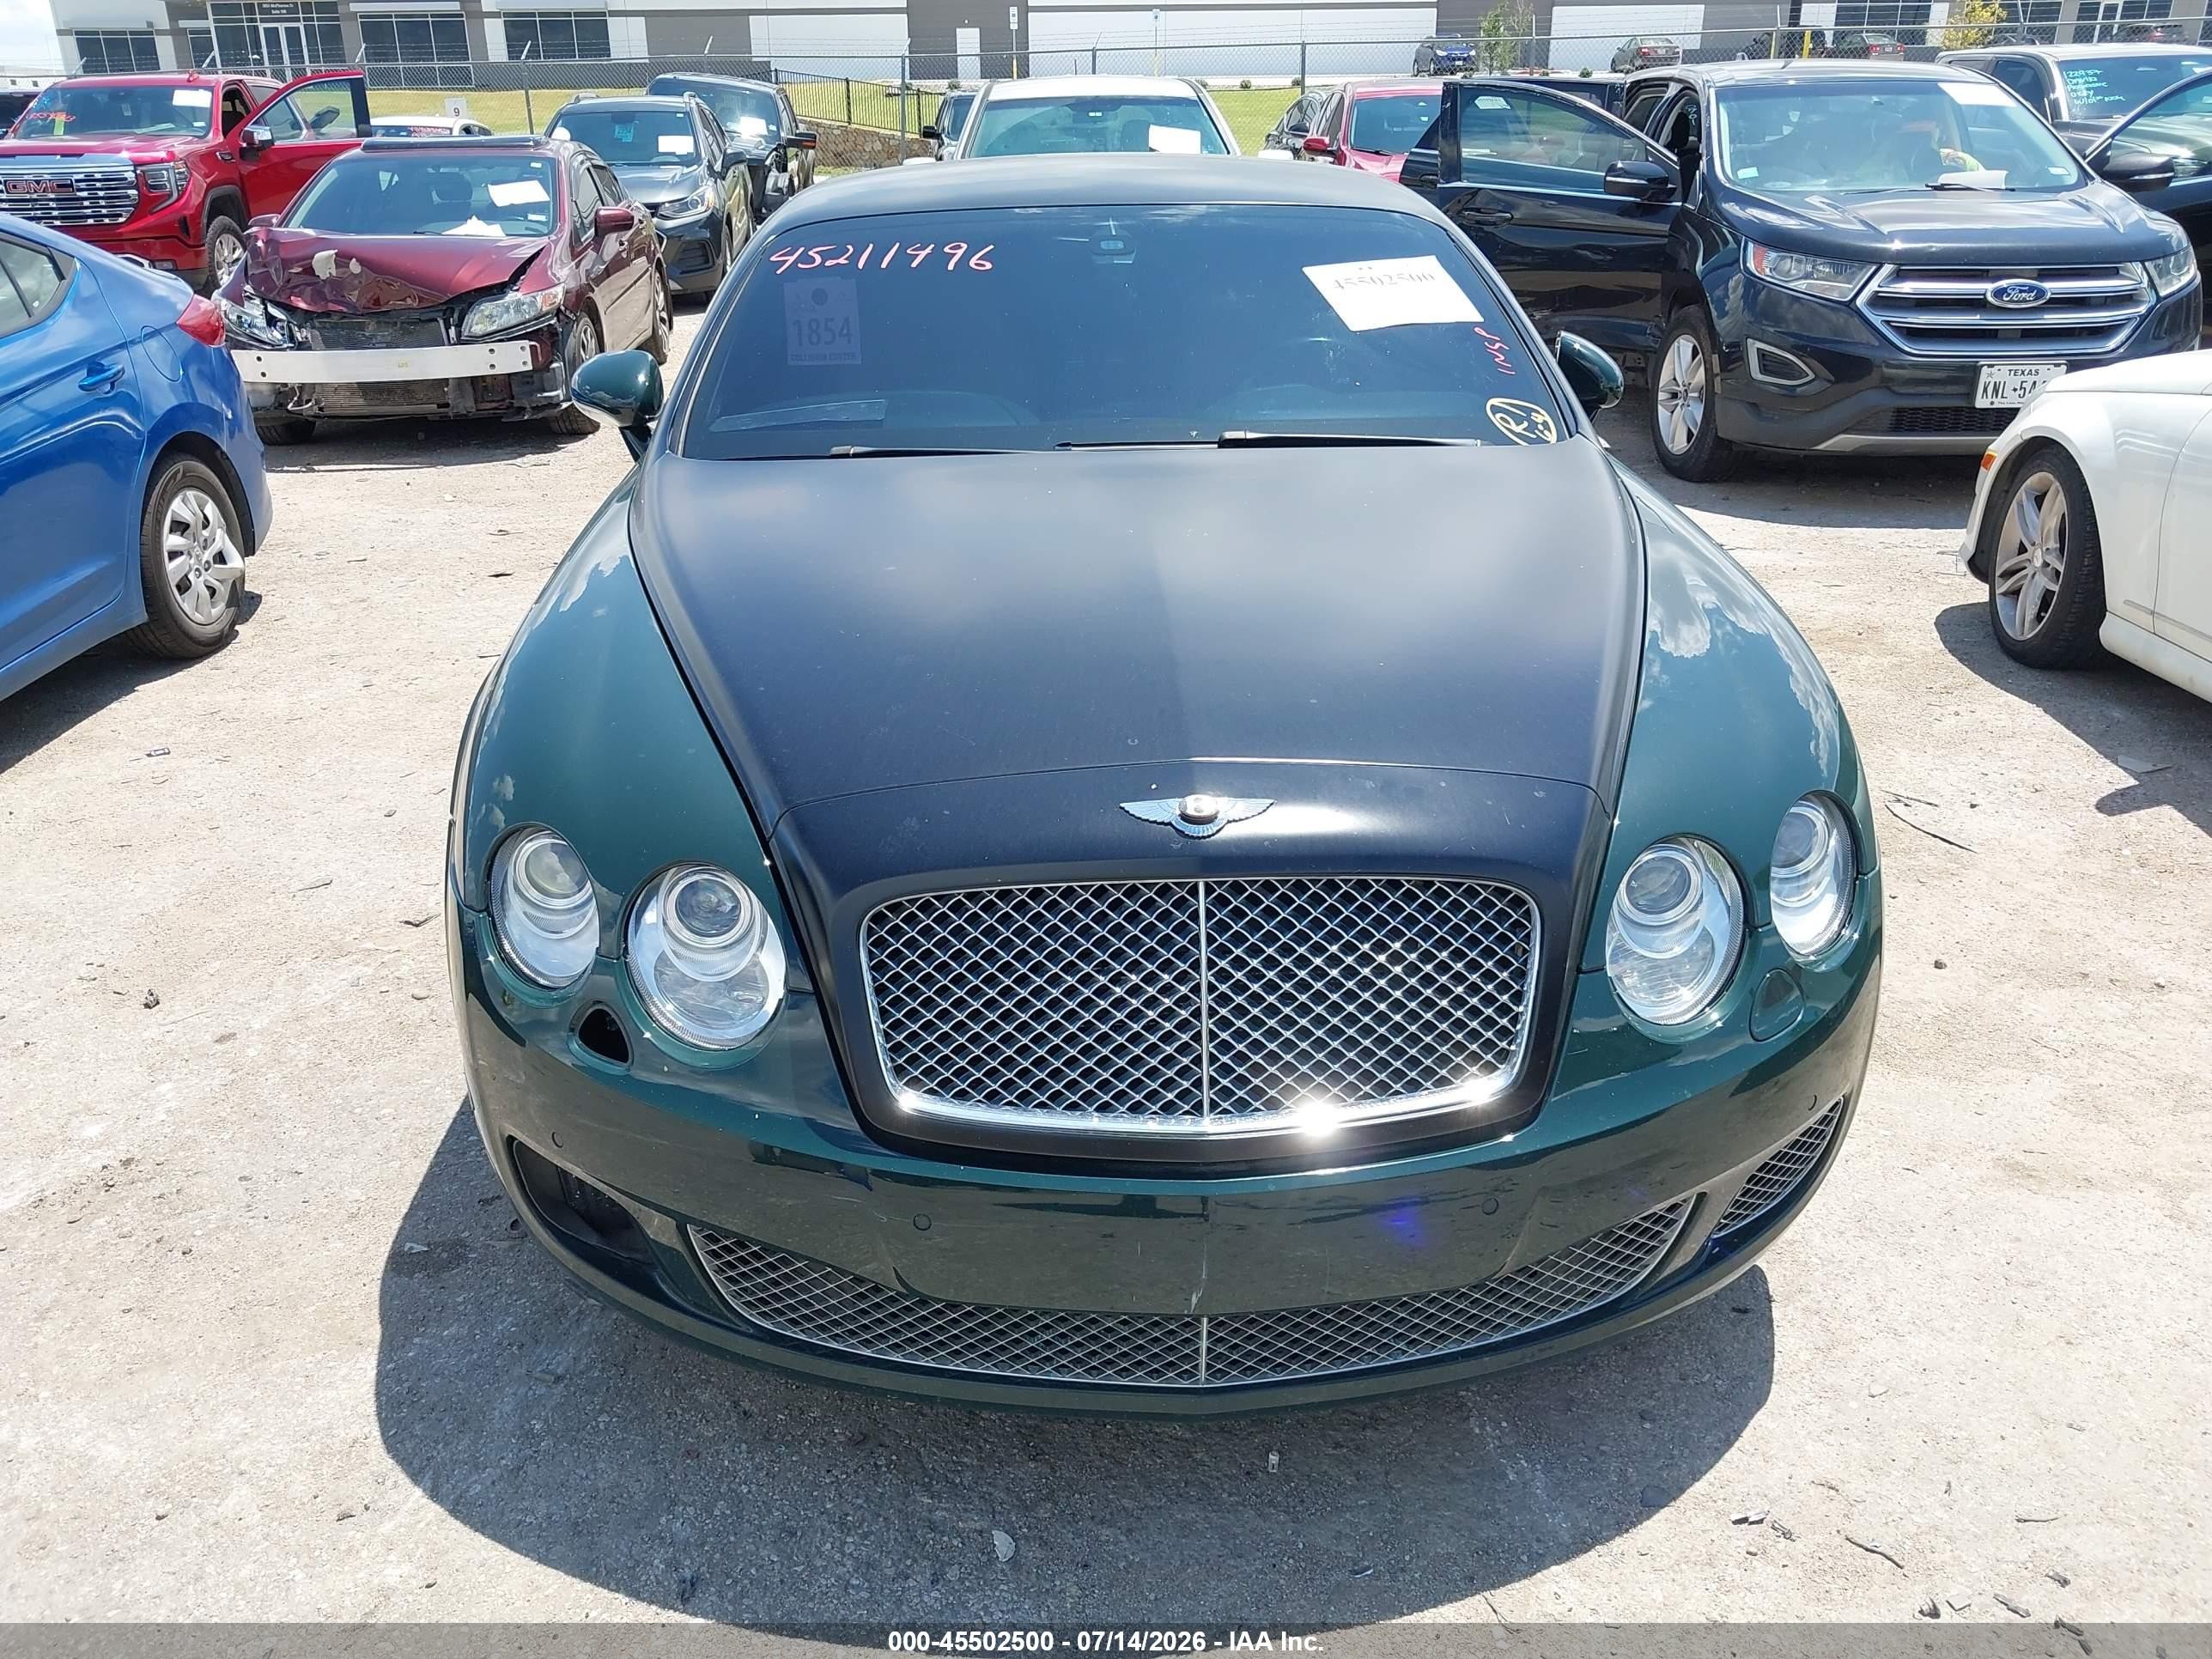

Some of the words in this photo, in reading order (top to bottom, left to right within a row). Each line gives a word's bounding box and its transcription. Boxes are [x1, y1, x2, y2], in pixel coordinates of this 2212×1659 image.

[453, 106, 461, 117] 9
[6, 179, 74, 193] GMC
[769, 241, 996, 275] 45211496
[2002, 285, 2038, 301] Ford
[792, 316, 854, 347] 1854
[2008, 368, 2040, 377] TEXAS
[1981, 380, 2008, 399] KNL
